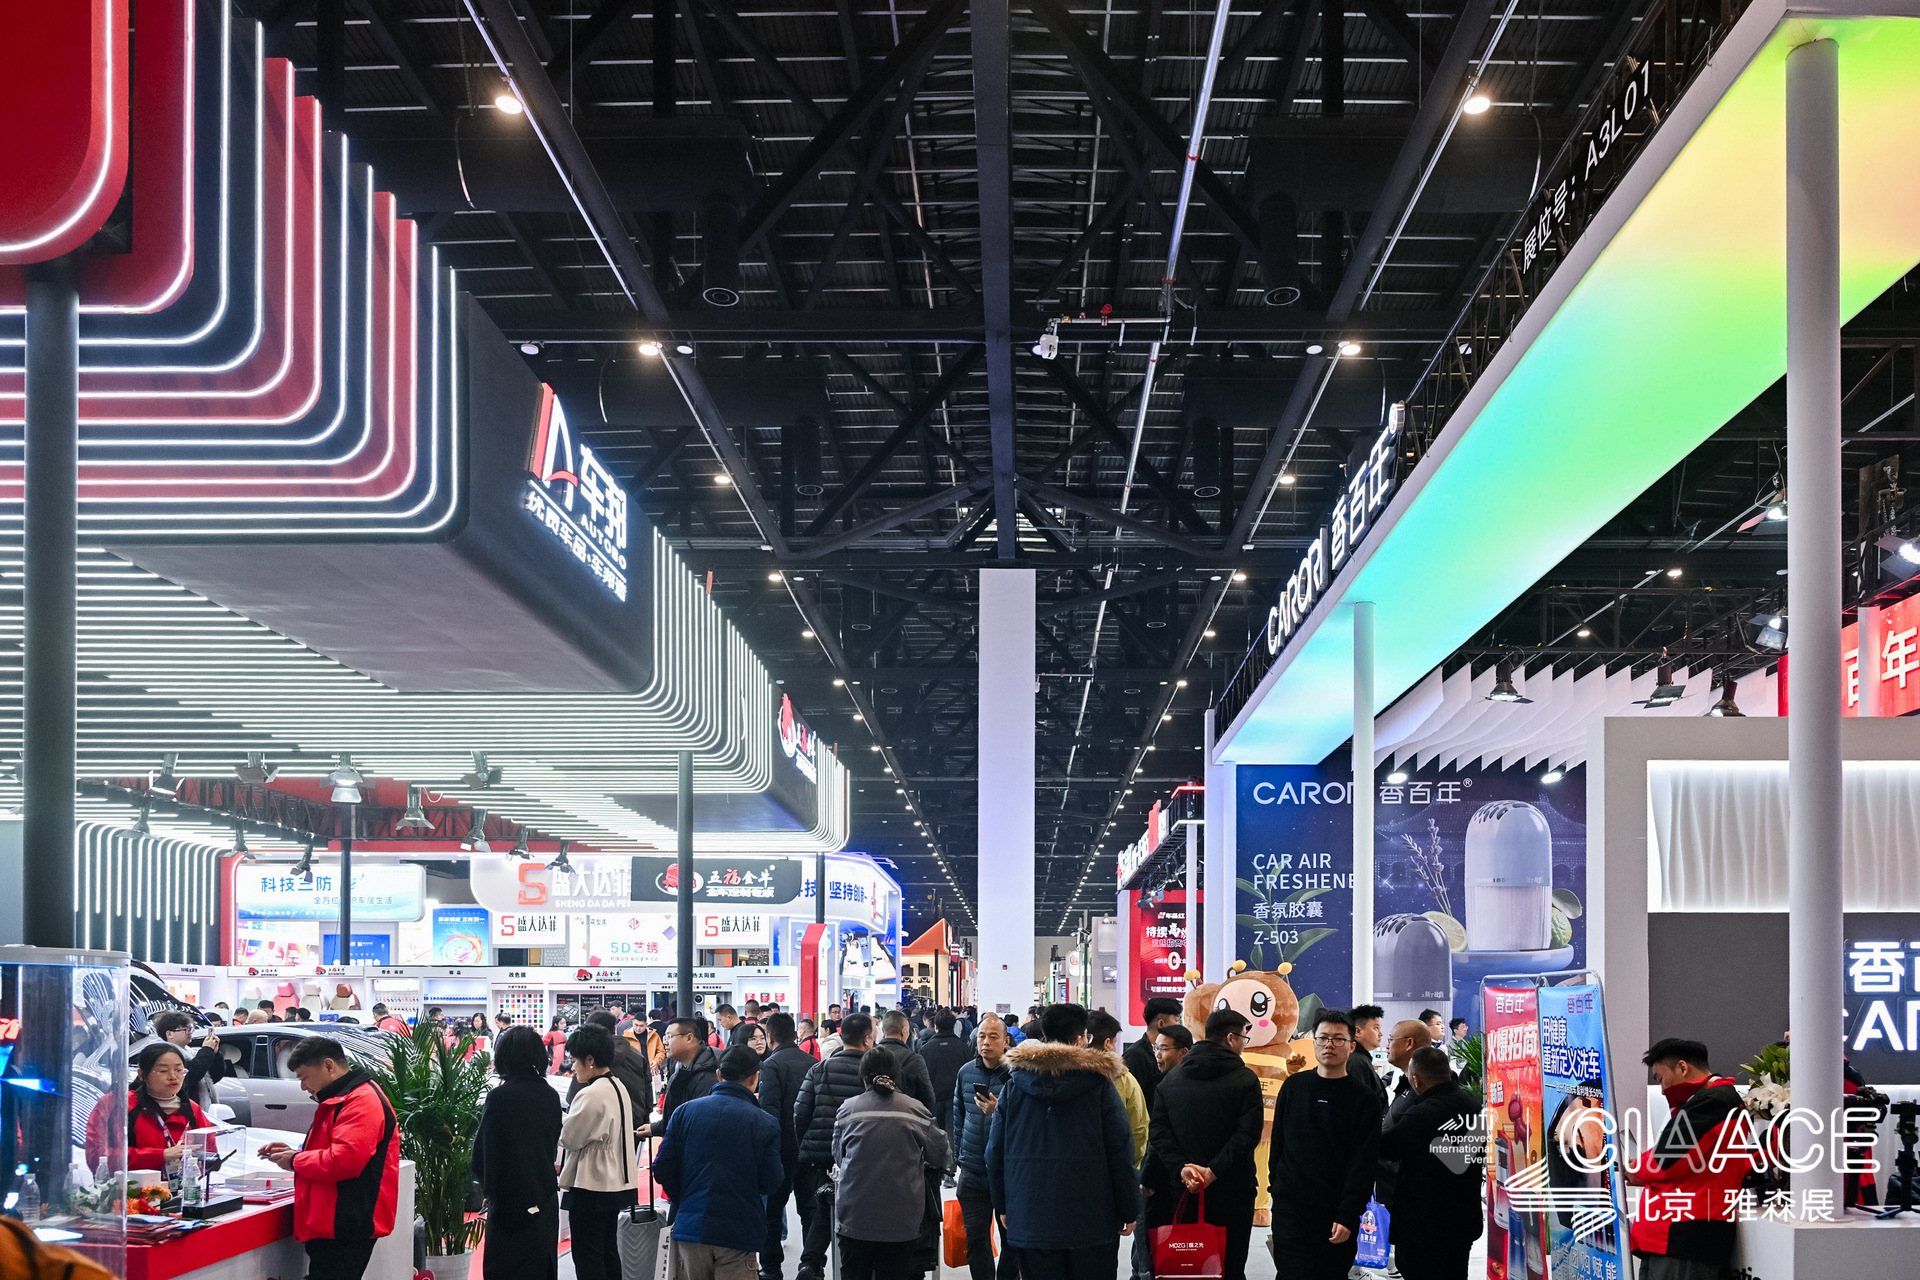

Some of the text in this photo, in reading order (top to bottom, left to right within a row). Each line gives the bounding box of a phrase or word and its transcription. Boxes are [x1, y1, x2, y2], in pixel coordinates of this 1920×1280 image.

[1254, 853, 1331, 869] CAR AIR
[707, 868, 773, 889] 五福金牛
[555, 900, 586, 908] SHENG
[588, 900, 602, 908] DA
[602, 900, 616, 908] DA
[1253, 901, 1323, 919] 香氛胶囊
[1254, 931, 1299, 945] Z-503
[1848, 941, 1920, 993] 香
[1543, 1017, 1567, 1046] 用健康
[1487, 1024, 1538, 1064] 火爆招商
[1544, 1046, 1600, 1080] 重新定义洗车
